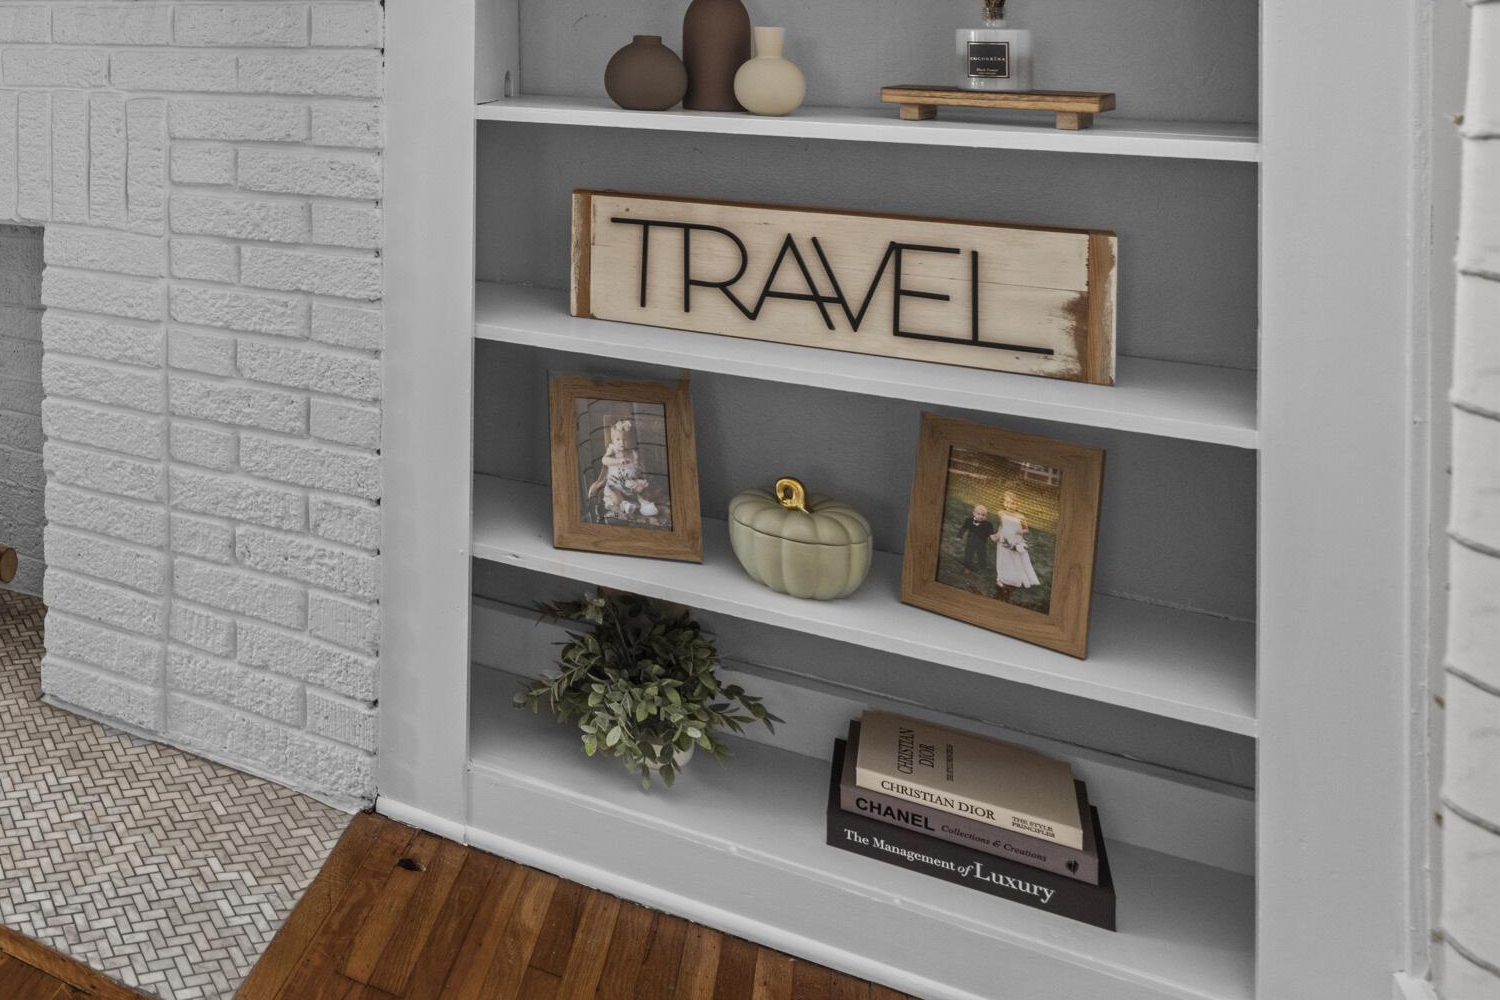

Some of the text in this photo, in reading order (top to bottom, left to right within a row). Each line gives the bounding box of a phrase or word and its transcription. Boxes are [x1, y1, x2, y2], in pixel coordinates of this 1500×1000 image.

[610, 217, 1054, 355] TRAVEL
[897, 726, 914, 775] CHRISTIAN
[918, 743, 935, 768] DIOR
[881, 780, 997, 821] CHRISTIAN DIOR
[855, 797, 1048, 862] CHANEL Collections & Creations
[1011, 816, 1054, 832] THE STYLE
[1011, 821, 1056, 838] PRINCIPLES
[843, 828, 1056, 904] The Management of Luxury
